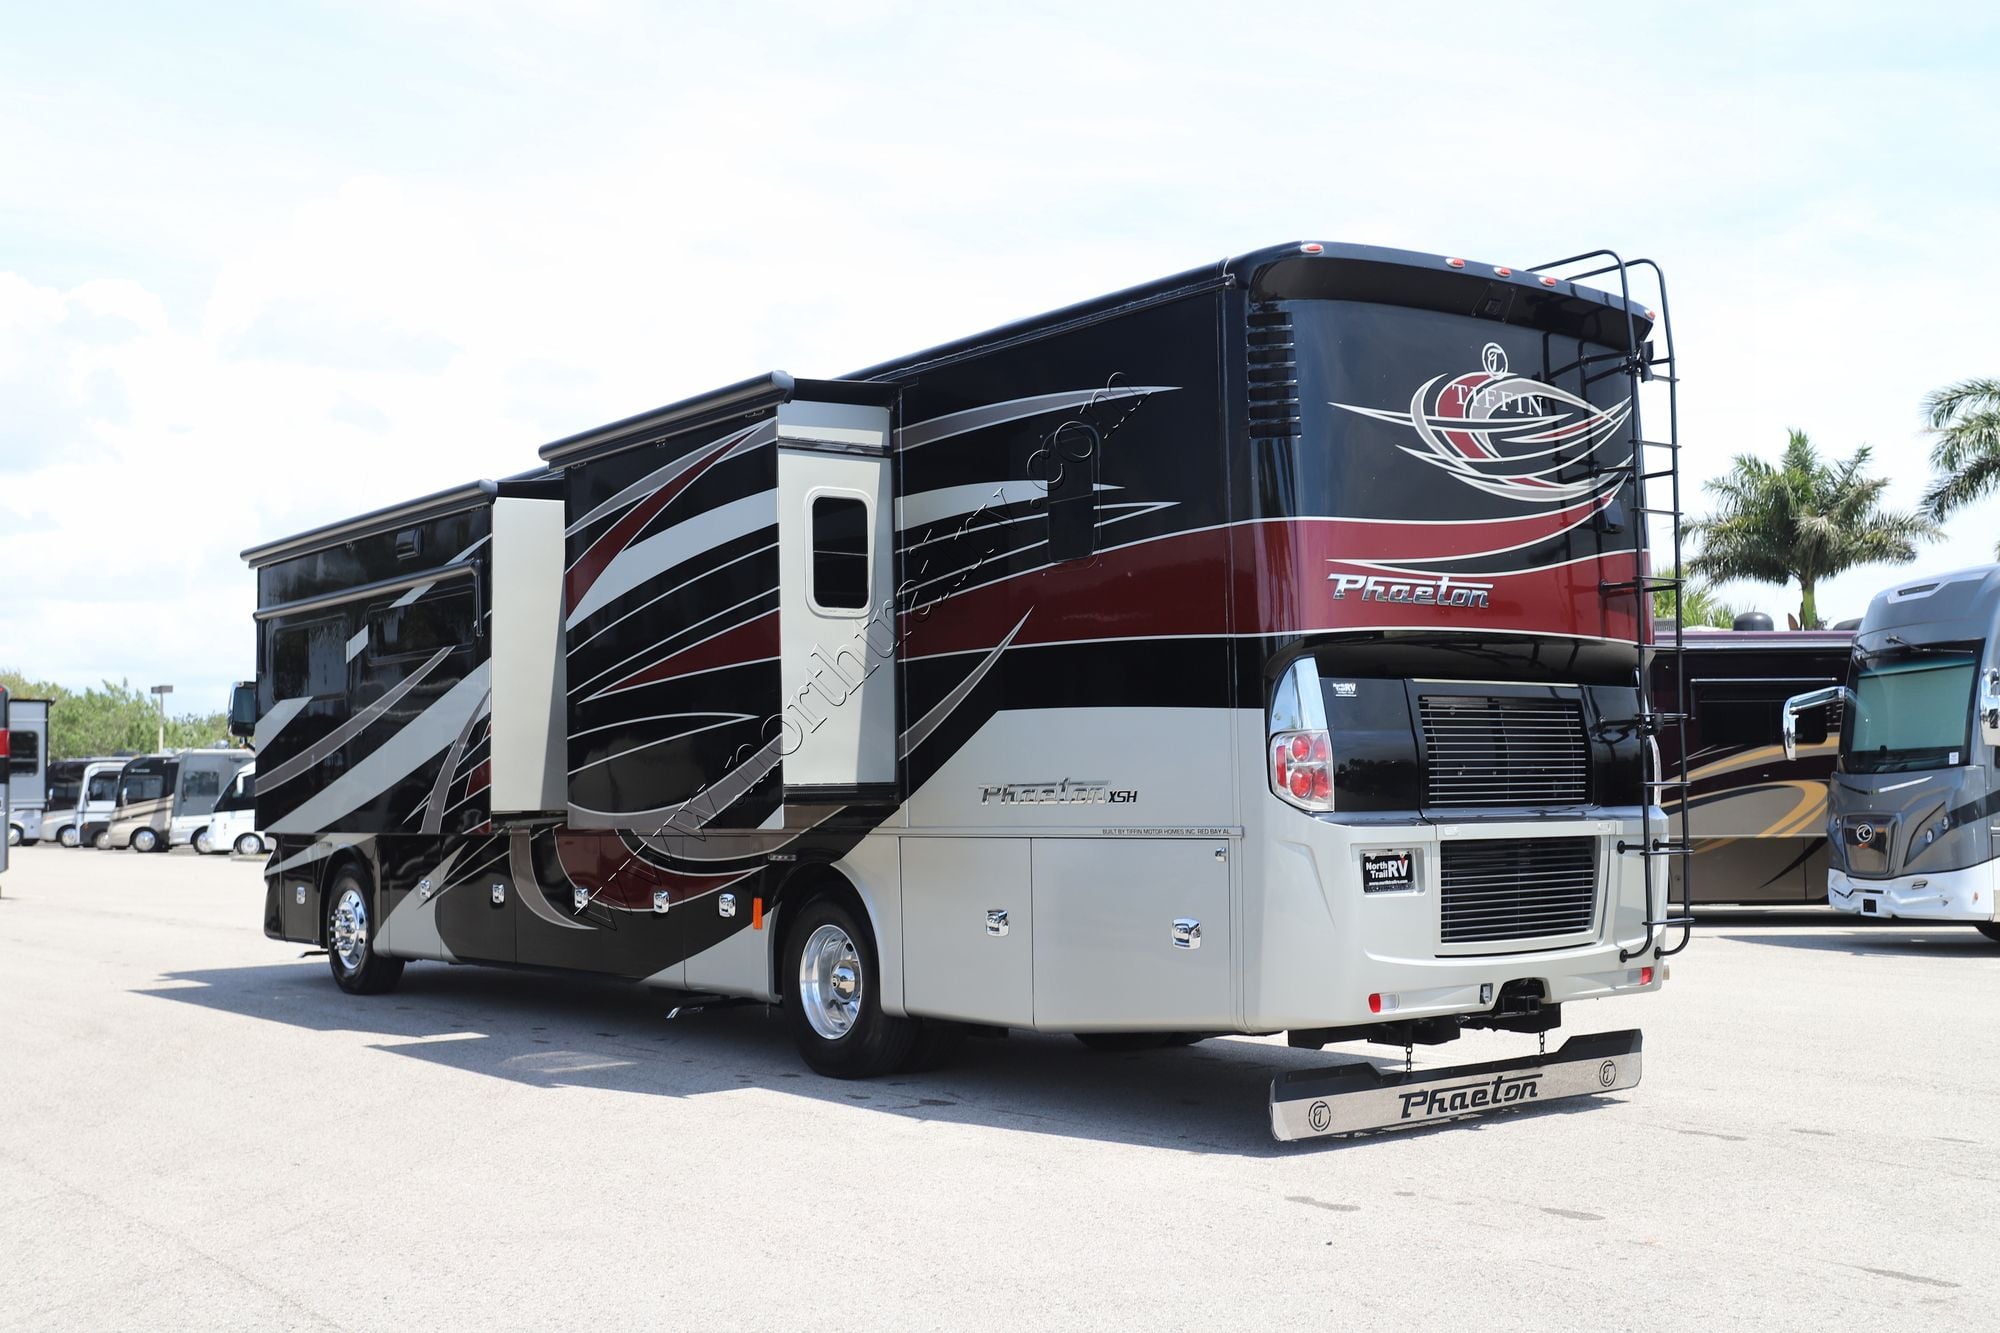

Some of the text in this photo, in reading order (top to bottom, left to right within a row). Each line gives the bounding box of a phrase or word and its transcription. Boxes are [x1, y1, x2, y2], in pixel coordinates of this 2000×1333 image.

[1451, 383, 1543, 417] TIFFIN
[1327, 573, 1494, 609] Phaeton
[978, 777, 1138, 806] Phaeton XSH
[1143, 828, 1163, 836] MOTOR
[1164, 828, 1184, 836] HOMES
[1197, 828, 1209, 836] RED
[1210, 828, 1222, 836] BAY
[1365, 861, 1388, 871] North
[1370, 869, 1388, 879] Trail
[1387, 860, 1409, 878] RV
[1398, 1073, 1543, 1119] Phaeton
